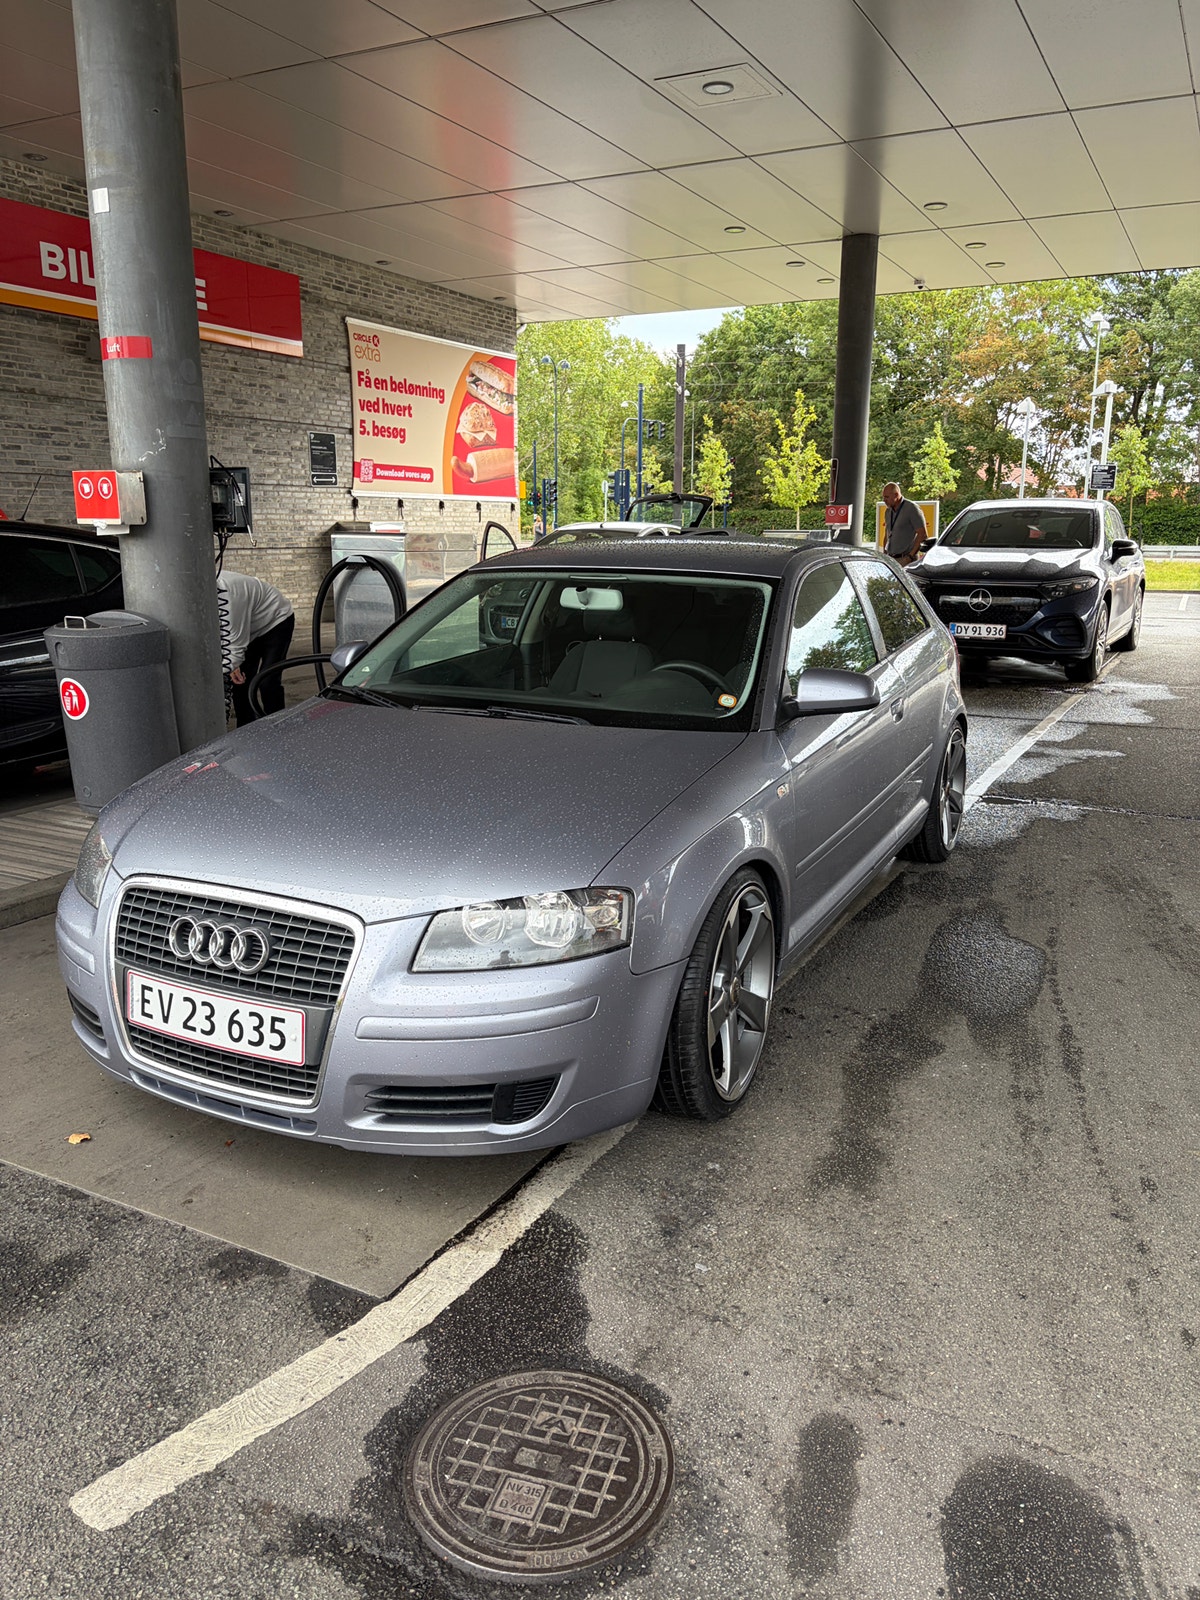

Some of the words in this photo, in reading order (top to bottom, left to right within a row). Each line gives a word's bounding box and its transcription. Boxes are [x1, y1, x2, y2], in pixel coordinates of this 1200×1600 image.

[353, 333, 371, 343] CIRCLE
[355, 344, 380, 362] extra
[357, 369, 372, 388] Få
[373, 378, 389, 390] en
[390, 376, 445, 404] belønning
[358, 398, 380, 414] ved
[382, 398, 413, 418] hvert
[359, 420, 370, 436] 5.
[372, 421, 406, 444] besøg
[376, 468, 405, 478] Download
[420, 473, 431, 481] app
[956, 625, 970, 635] DY
[971, 626, 982, 636] 91
[985, 626, 1004, 636] 936
[140, 984, 174, 1025] EV
[182, 996, 216, 1036] 23
[227, 1009, 287, 1052] 635
[506, 1482, 524, 1493] NV
[524, 1486, 541, 1498] 315
[510, 1502, 533, 1515] 400
